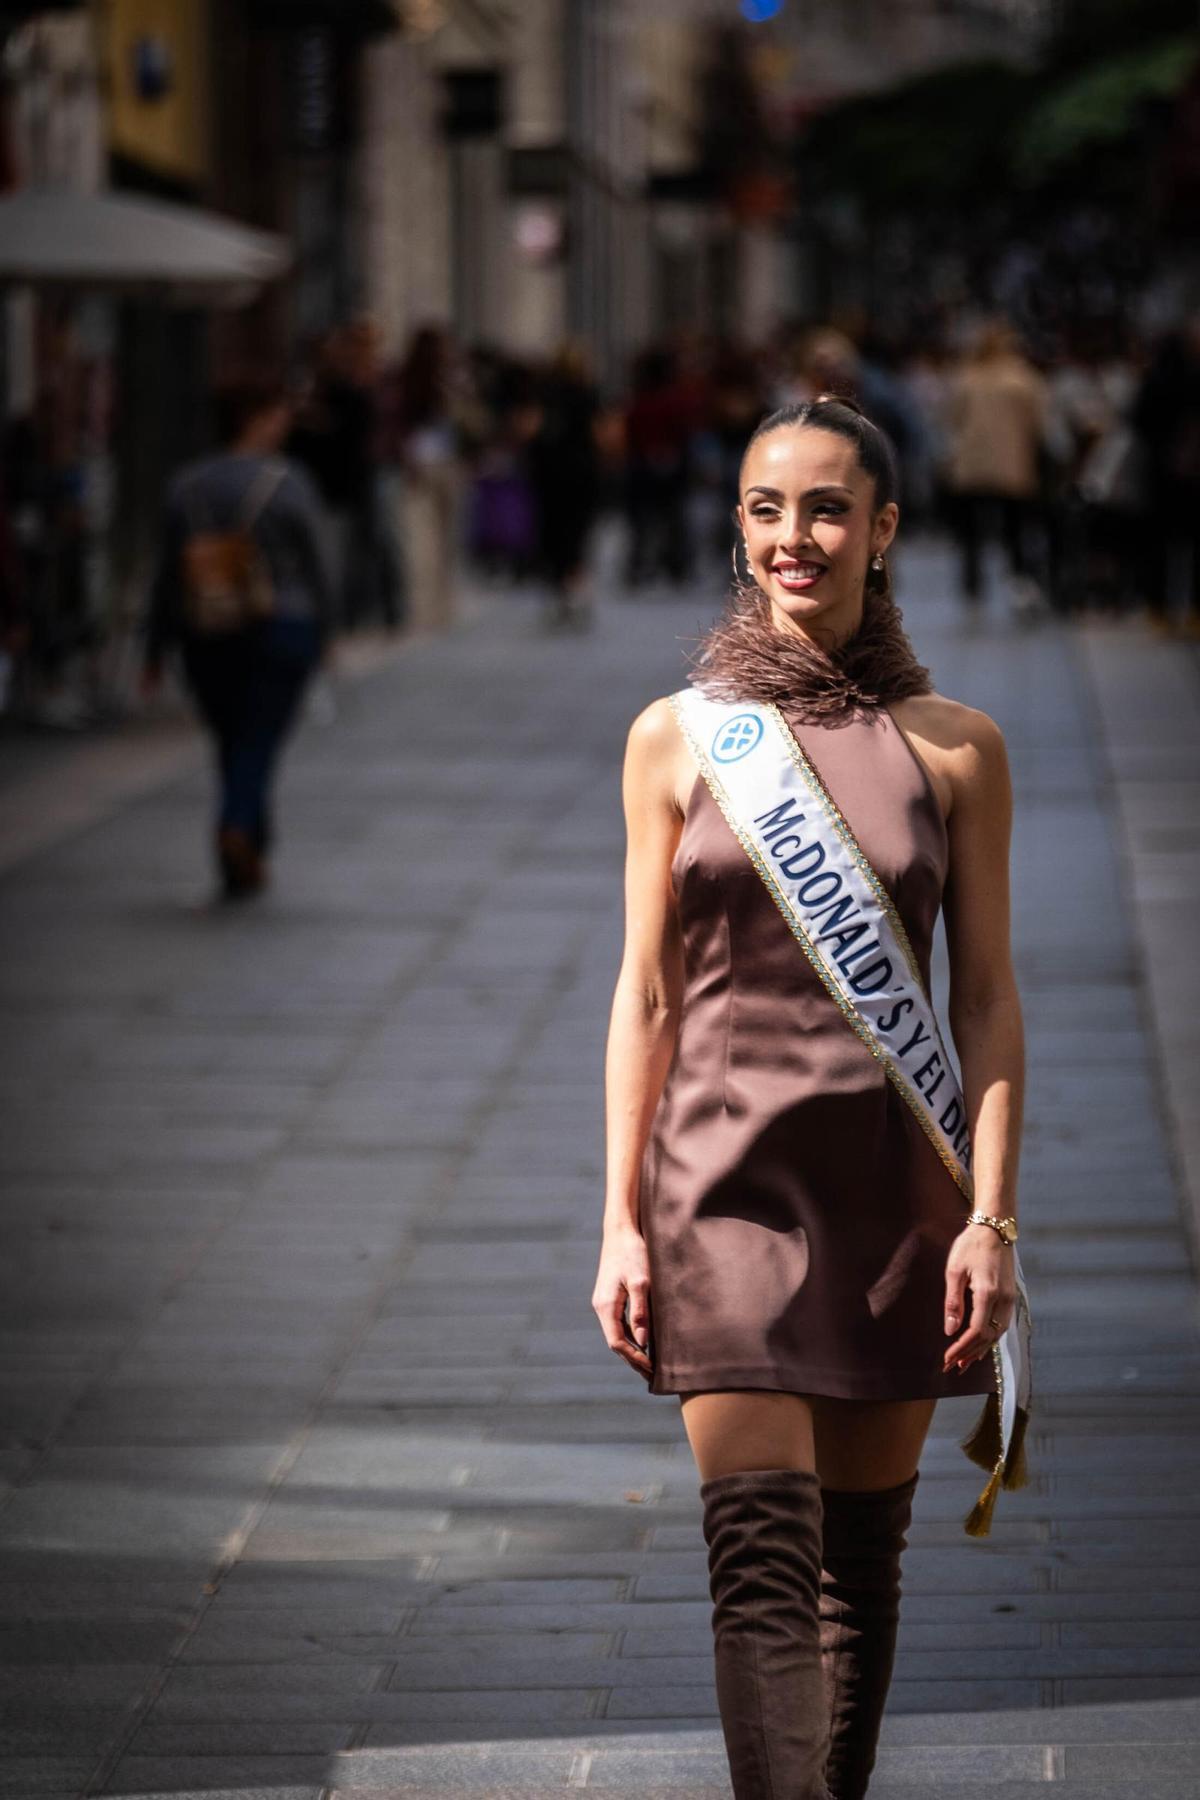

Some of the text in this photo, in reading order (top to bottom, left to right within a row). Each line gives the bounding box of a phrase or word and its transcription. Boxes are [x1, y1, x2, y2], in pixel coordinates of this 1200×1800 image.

[753, 797, 914, 1032] McDONALD'S
[896, 1020, 931, 1058] Y
[912, 1050, 946, 1108] EL
